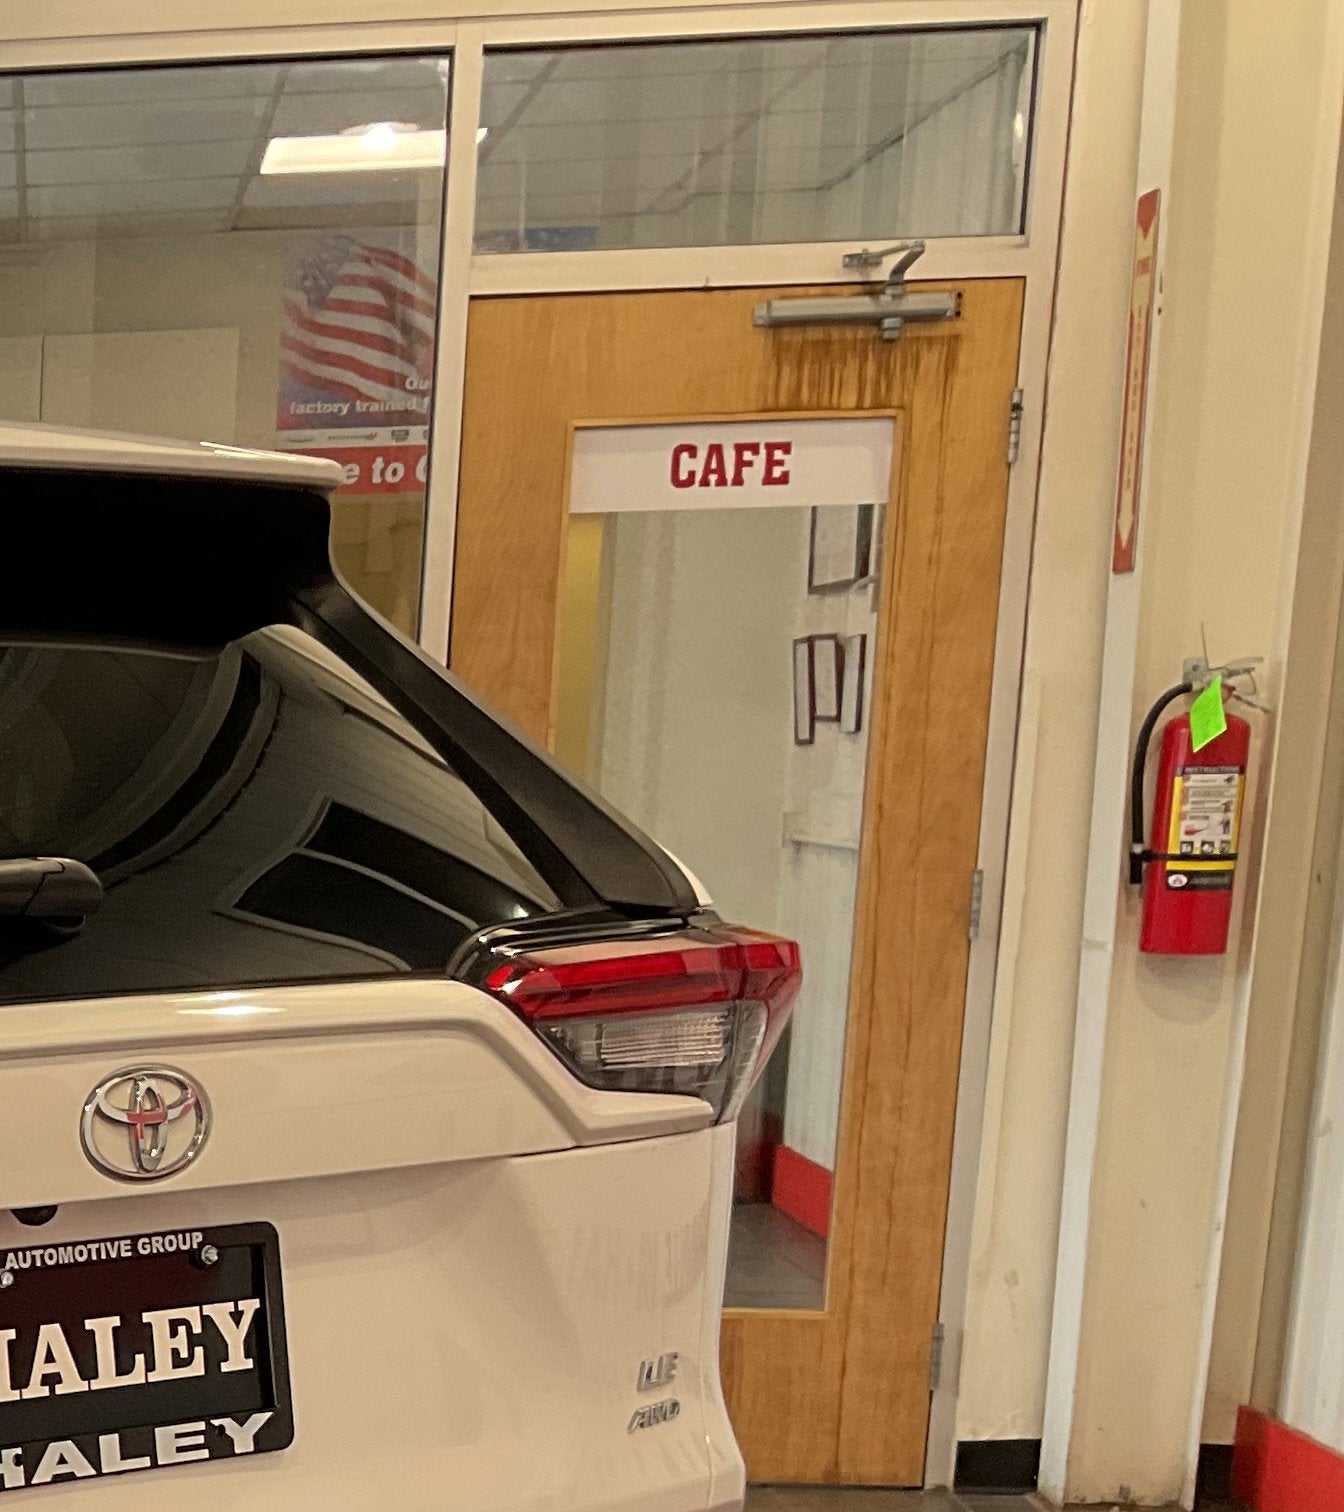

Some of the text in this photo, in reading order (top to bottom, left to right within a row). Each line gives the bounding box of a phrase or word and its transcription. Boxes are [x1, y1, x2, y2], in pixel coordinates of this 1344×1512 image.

[289, 401, 351, 415] factory
[356, 398, 417, 412] trained
[372, 456, 404, 484] to
[670, 441, 793, 489] CAFE
[4, 1232, 203, 1270] AUTOMOTIVE GROUP
